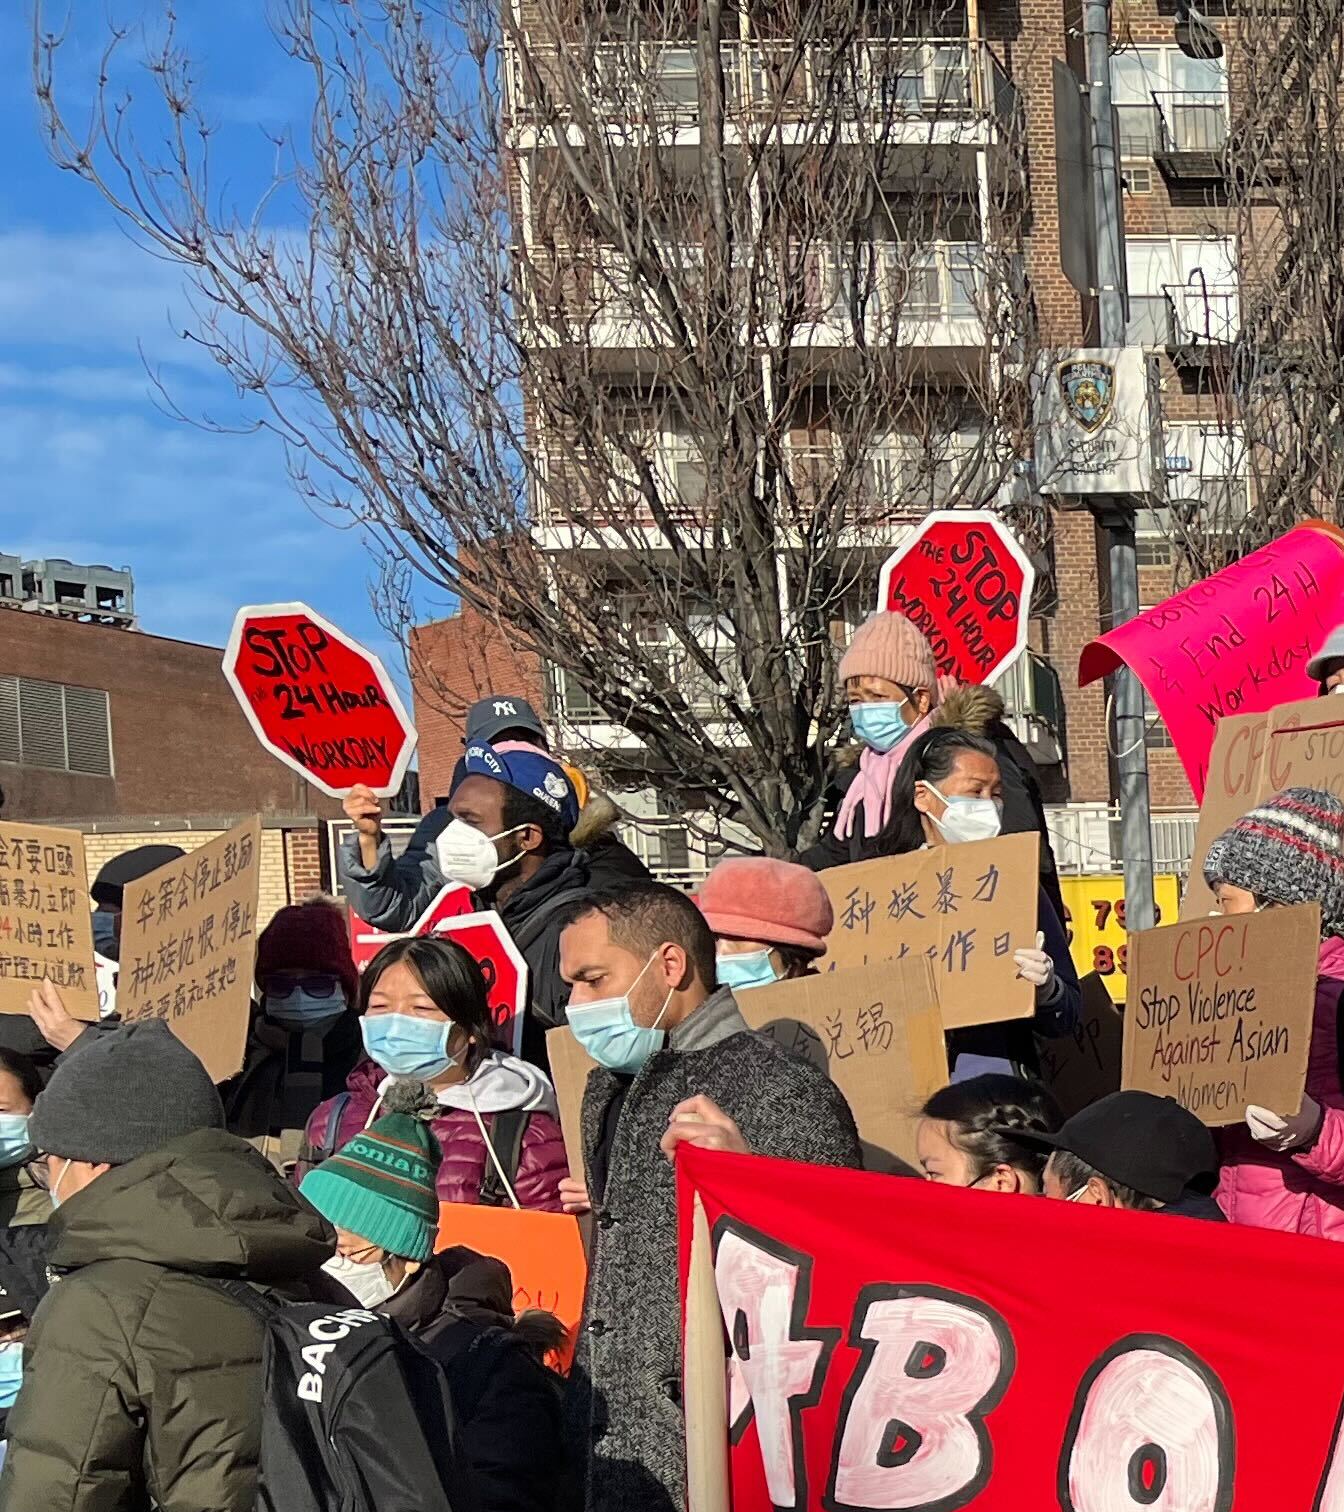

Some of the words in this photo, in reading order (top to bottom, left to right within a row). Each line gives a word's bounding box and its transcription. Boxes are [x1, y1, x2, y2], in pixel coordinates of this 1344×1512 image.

[919, 538, 945, 566] THE
[951, 530, 1019, 623] STOP
[928, 567, 969, 620] 24
[957, 609, 997, 671] HOUR
[1180, 614, 1247, 678] End
[245, 621, 329, 680] STOP
[273, 683, 317, 720] 24
[286, 735, 391, 771] WORKDAY
[484, 753, 503, 774] CITY
[1174, 923, 1249, 981] CPC!
[1136, 984, 1181, 1035] Stop
[1188, 981, 1257, 1025] Violence
[1150, 1025, 1221, 1082] Against
[1226, 1017, 1290, 1064] Asian
[1177, 1065, 1249, 1112] Women!
